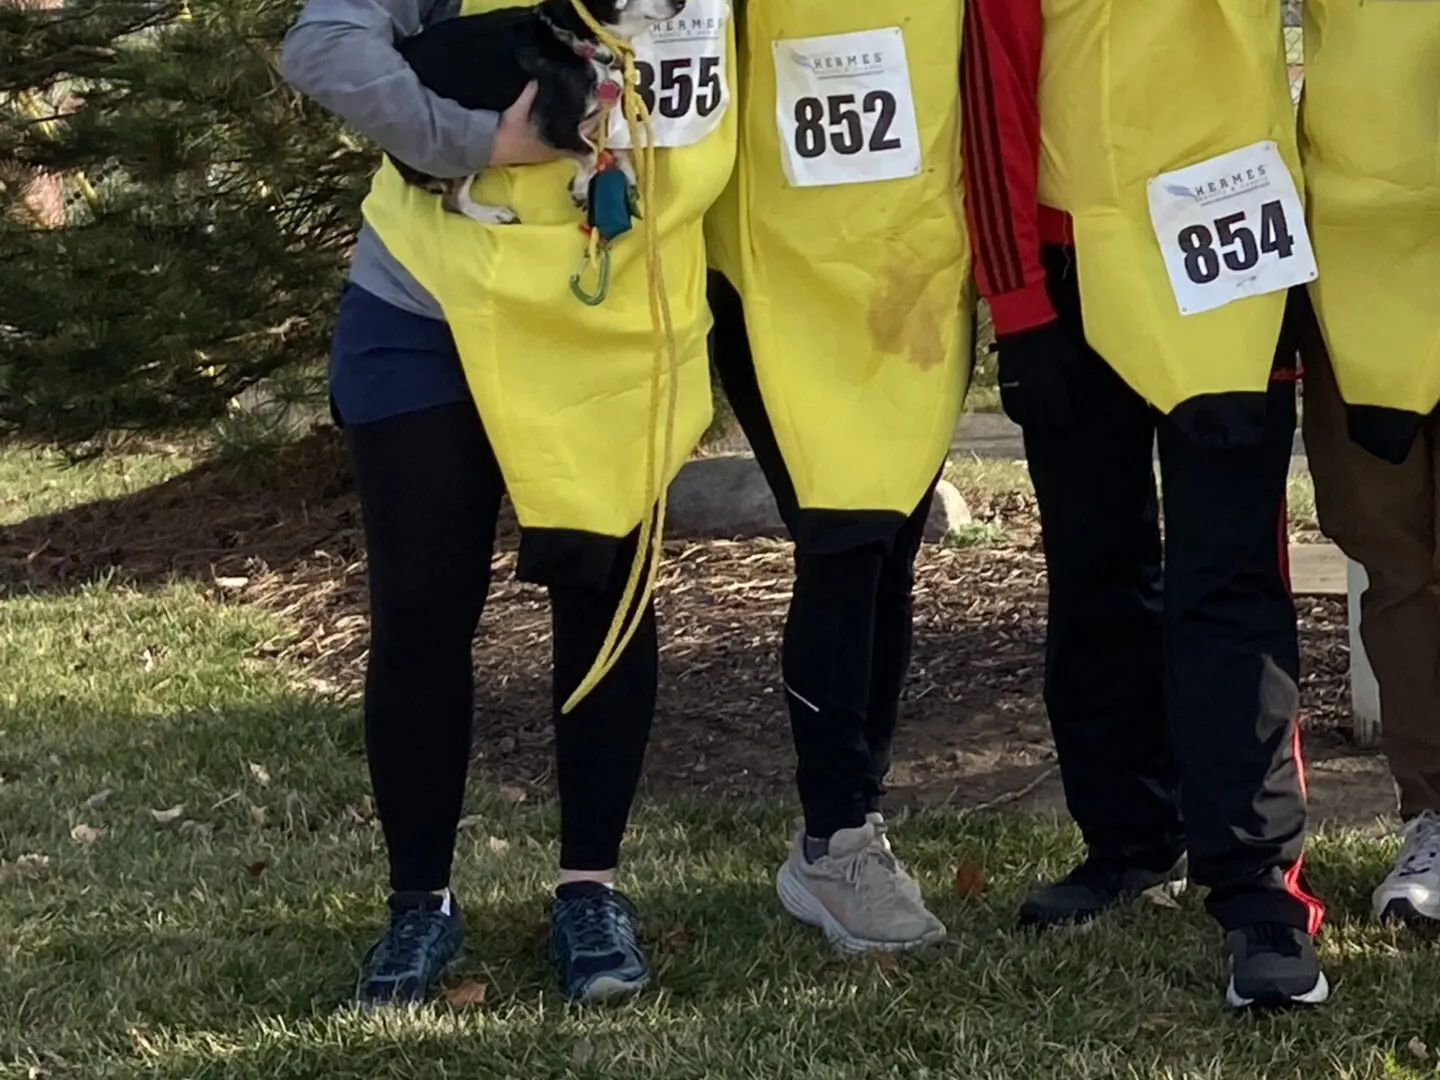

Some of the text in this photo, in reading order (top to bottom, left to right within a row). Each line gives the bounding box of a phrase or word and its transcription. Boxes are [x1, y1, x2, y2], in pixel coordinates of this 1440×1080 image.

[813, 52, 884, 69] HERMES
[794, 90, 901, 158] 852
[1194, 164, 1267, 197] HERMES
[1177, 199, 1295, 284] 854
